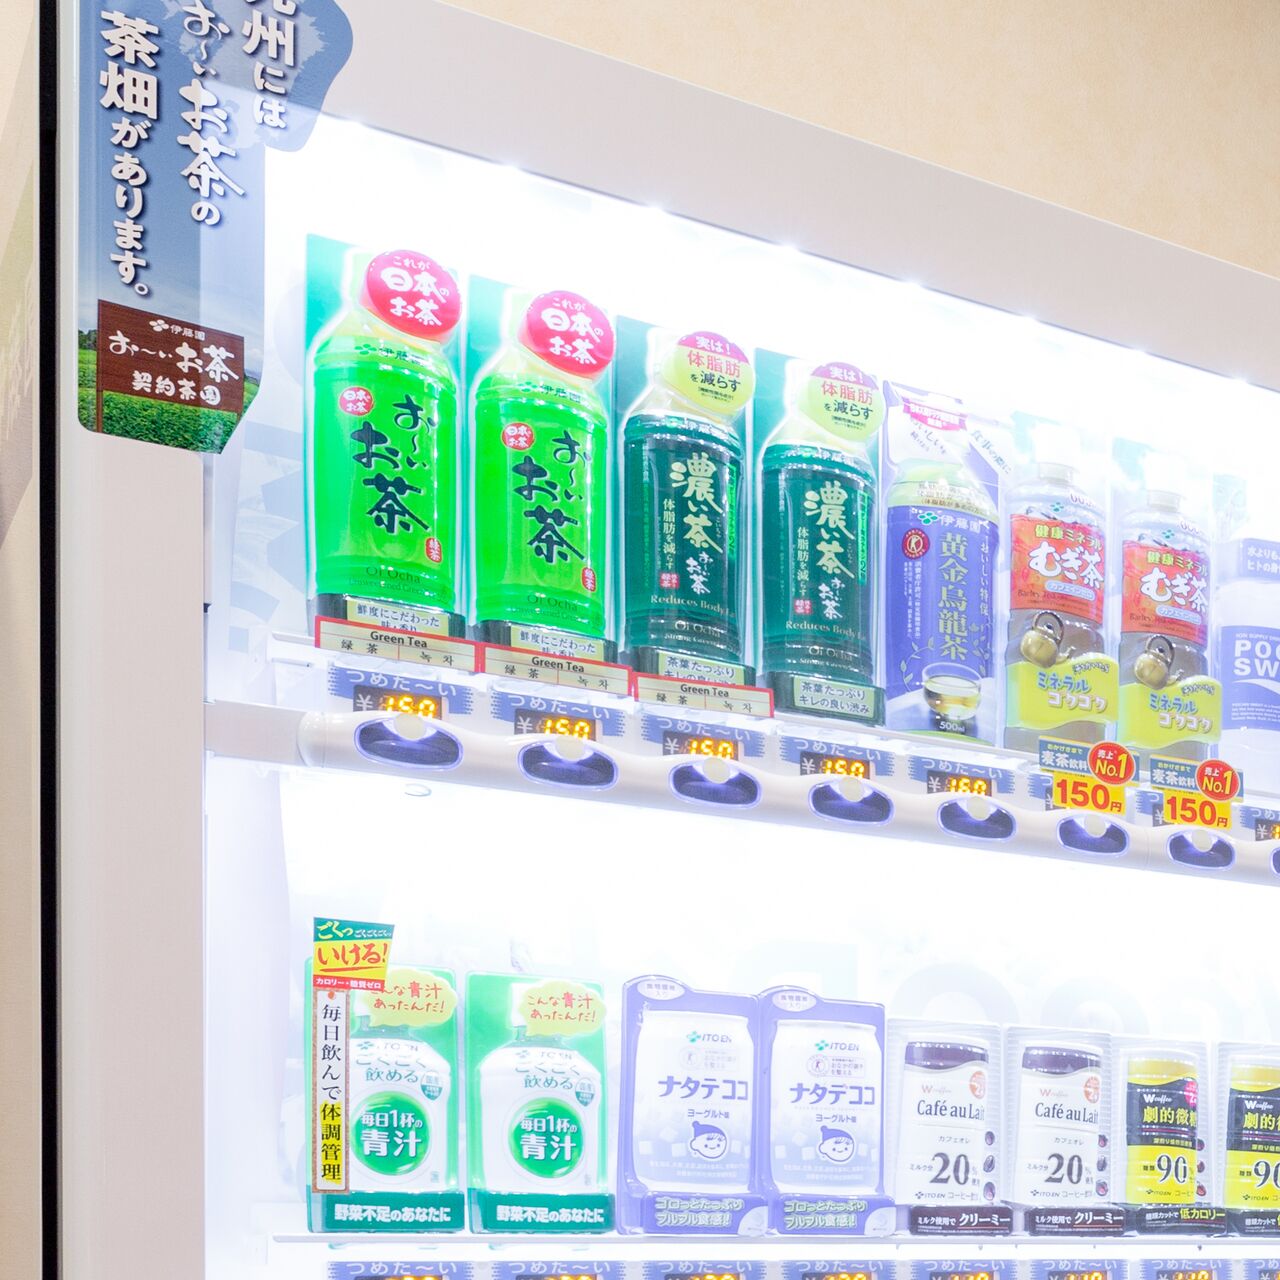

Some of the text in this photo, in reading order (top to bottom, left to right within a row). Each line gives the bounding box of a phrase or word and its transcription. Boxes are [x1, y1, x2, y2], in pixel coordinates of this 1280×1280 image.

[99, 10, 160, 295] 茶畑があります。
[380, 267, 450, 303] 日本の
[389, 297, 442, 326] お茶
[171, 320, 206, 341] 伊藤園
[687, 350, 741, 378] 体脂肪
[131, 369, 221, 406] 契約茶園
[690, 370, 741, 393] を減らす
[821, 381, 874, 406] 体脂肪
[350, 421, 431, 534] お茶
[512, 455, 586, 563] お茶
[670, 452, 723, 554] 濃い茶
[1029, 542, 1104, 589] むぎ茶
[1140, 568, 1209, 613] むぎ茶
[356, 604, 441, 628] 鮮度にこだわった
[370, 631, 427, 649] Green Tea
[519, 629, 596, 654] 鮮度にこだわった
[532, 656, 584, 674] Green Tea
[667, 656, 735, 678] 茶葉たっぷり
[349, 669, 456, 696] つめた〜い
[680, 682, 729, 698] Green Tea
[802, 682, 866, 700] 茶葉たっぷり
[1038, 672, 1089, 693] ミネラル
[799, 695, 870, 715] キレの良い渋み
[1041, 751, 1089, 772] 麦茶飲料
[1095, 753, 1128, 778] No.1
[1056, 779, 1122, 813] 150円
[1167, 797, 1228, 826] 150円
[317, 942, 388, 966] いける!
[374, 997, 444, 1013] あったんだ!
[365, 1067, 419, 1083] 飲める
[523, 1074, 574, 1090] 飲める
[320, 1003, 342, 1182] 毎日飲んで体調管理
[360, 1109, 423, 1129] 毎日1杯の
[520, 1116, 577, 1135] 毎日1杯の
[360, 1130, 423, 1158] 青汁
[520, 1135, 577, 1162] 青汁
[929, 1152, 970, 1186] 20
[1044, 1153, 1083, 1184] 20
[1156, 1154, 1187, 1185] 90
[334, 1204, 451, 1224] 野菜不足のあなたに
[496, 1205, 604, 1224] 野菜不足のあなたに
[917, 1213, 1011, 1228] ミルク使用で クリーミー
[1180, 1209, 1227, 1222] 低カロリー
